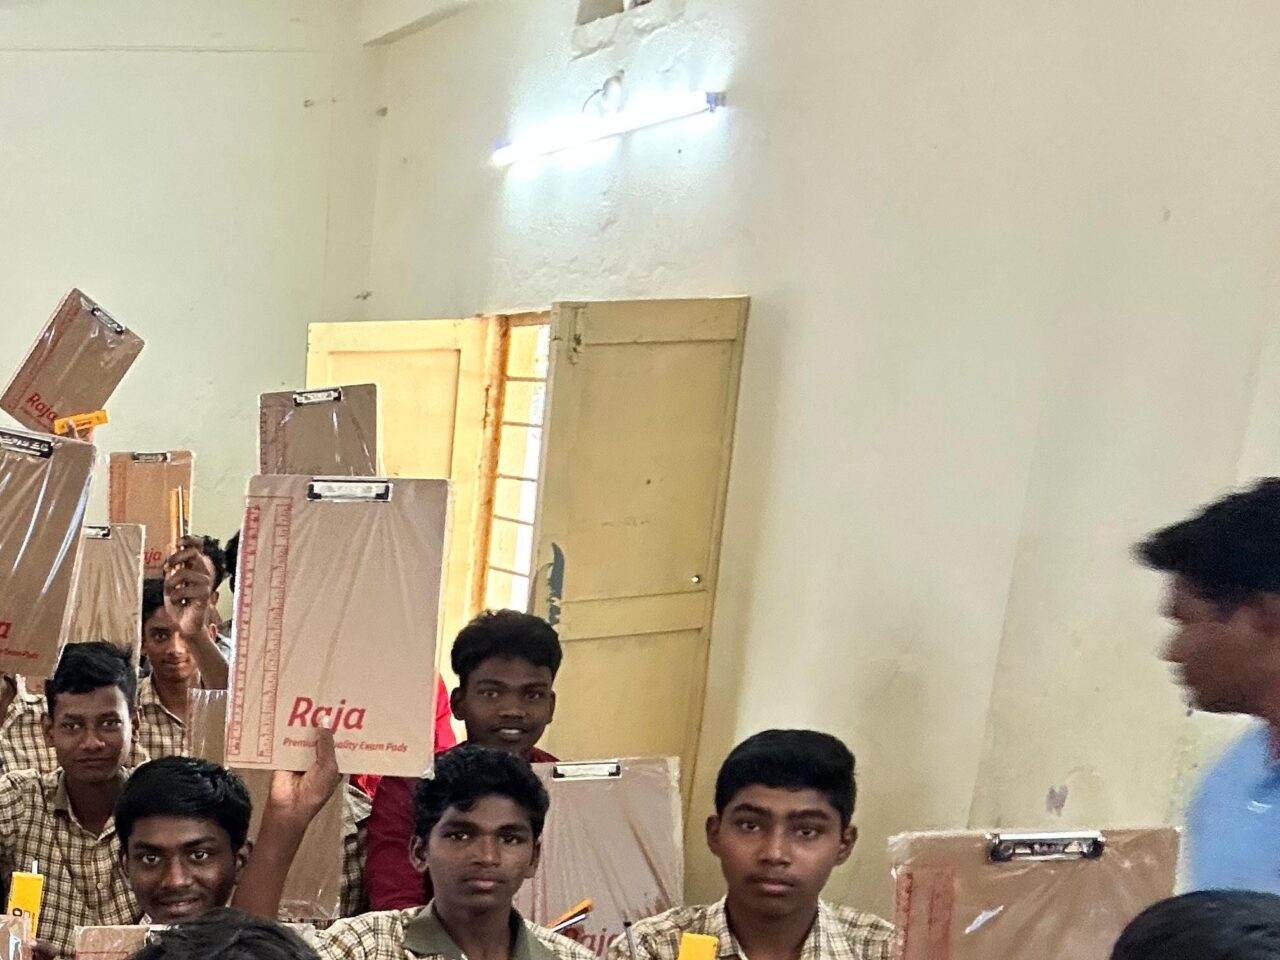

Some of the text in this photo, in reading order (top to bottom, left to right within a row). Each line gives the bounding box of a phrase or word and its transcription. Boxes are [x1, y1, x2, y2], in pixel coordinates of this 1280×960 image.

[27, 392, 59, 421] Raja
[287, 696, 366, 735] Raja
[359, 741, 385, 751] Exam
[385, 742, 408, 753] Pads
